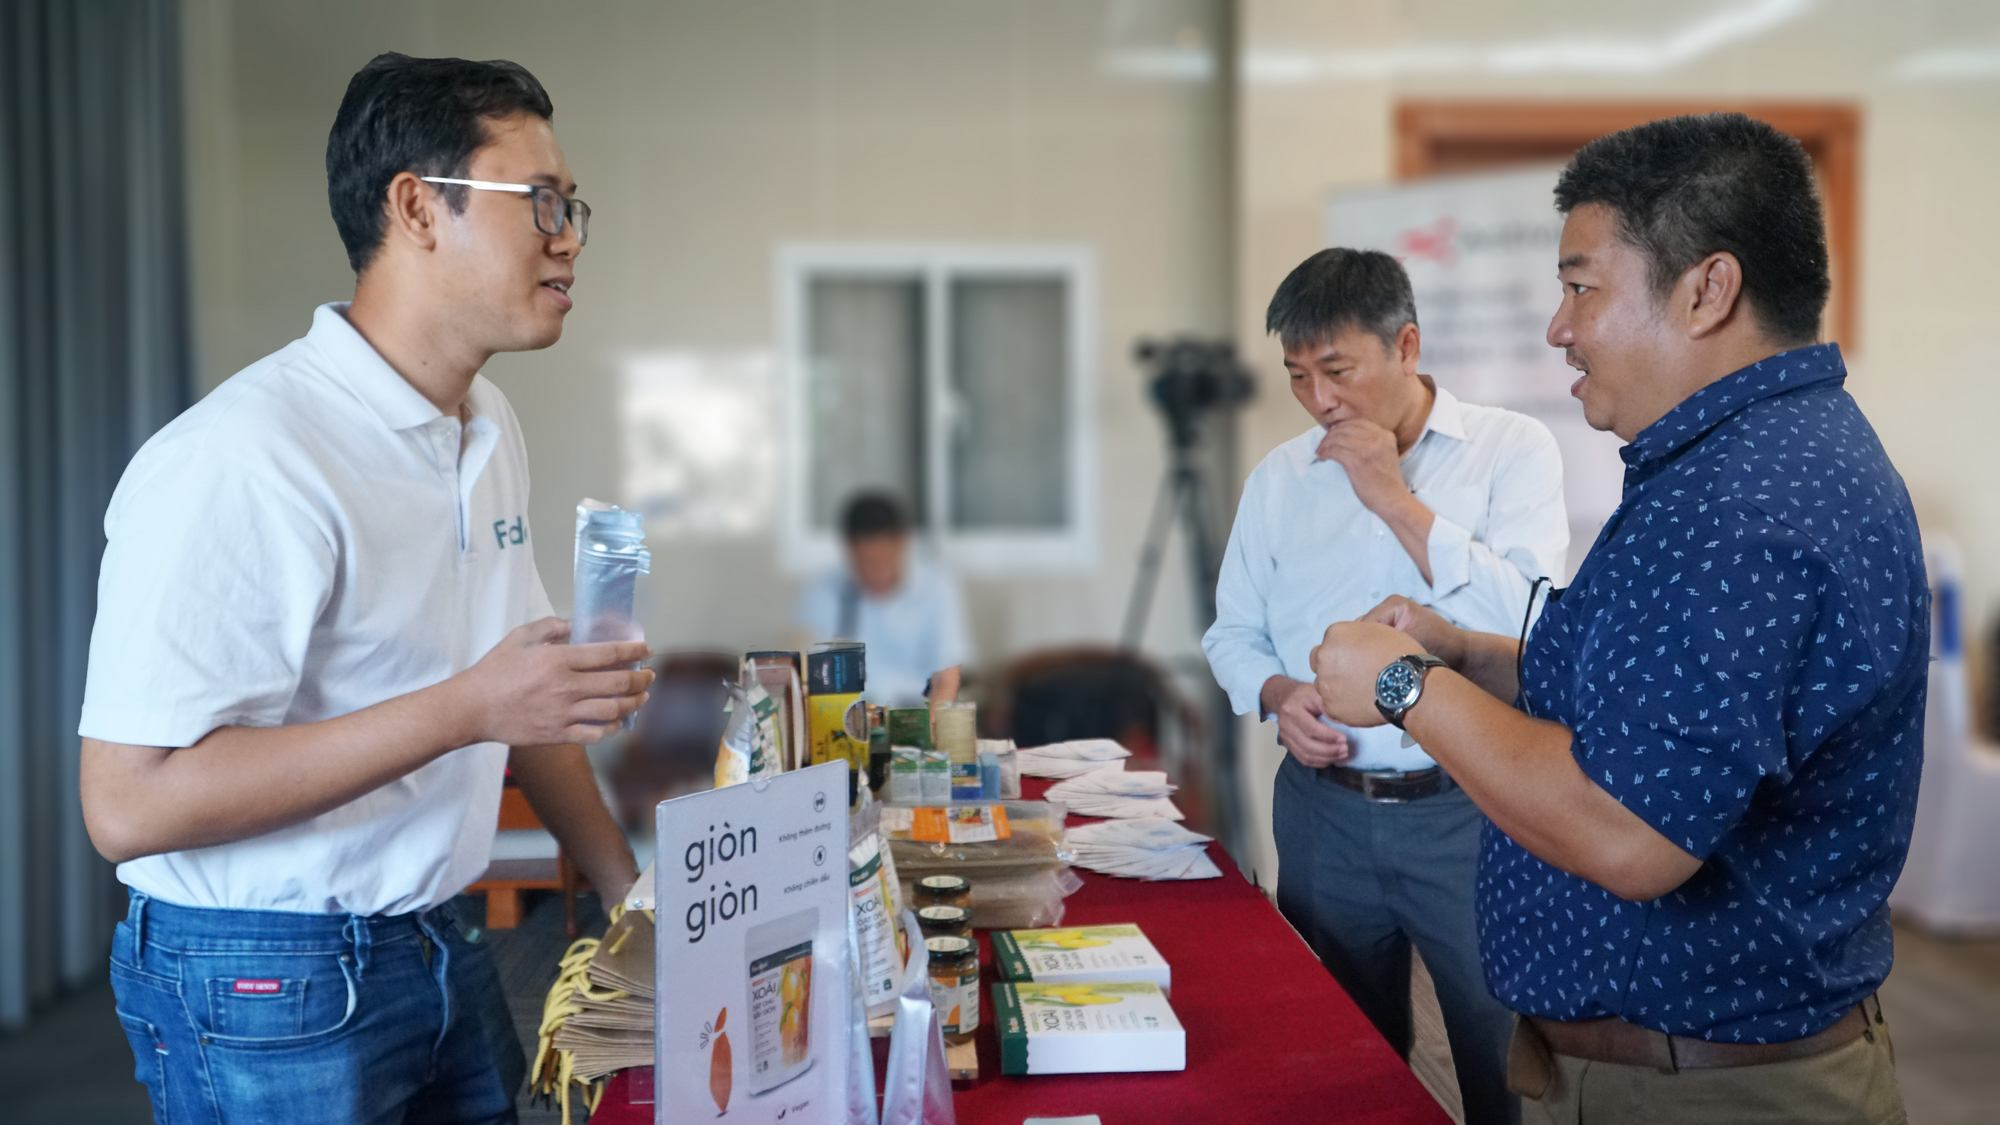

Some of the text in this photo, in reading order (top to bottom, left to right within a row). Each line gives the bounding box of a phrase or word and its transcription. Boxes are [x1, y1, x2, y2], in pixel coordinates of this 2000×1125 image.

[685, 821, 757, 883] giòn
[779, 832, 798, 843] Không
[784, 882, 803, 894] Không
[686, 880, 758, 943] giòn
